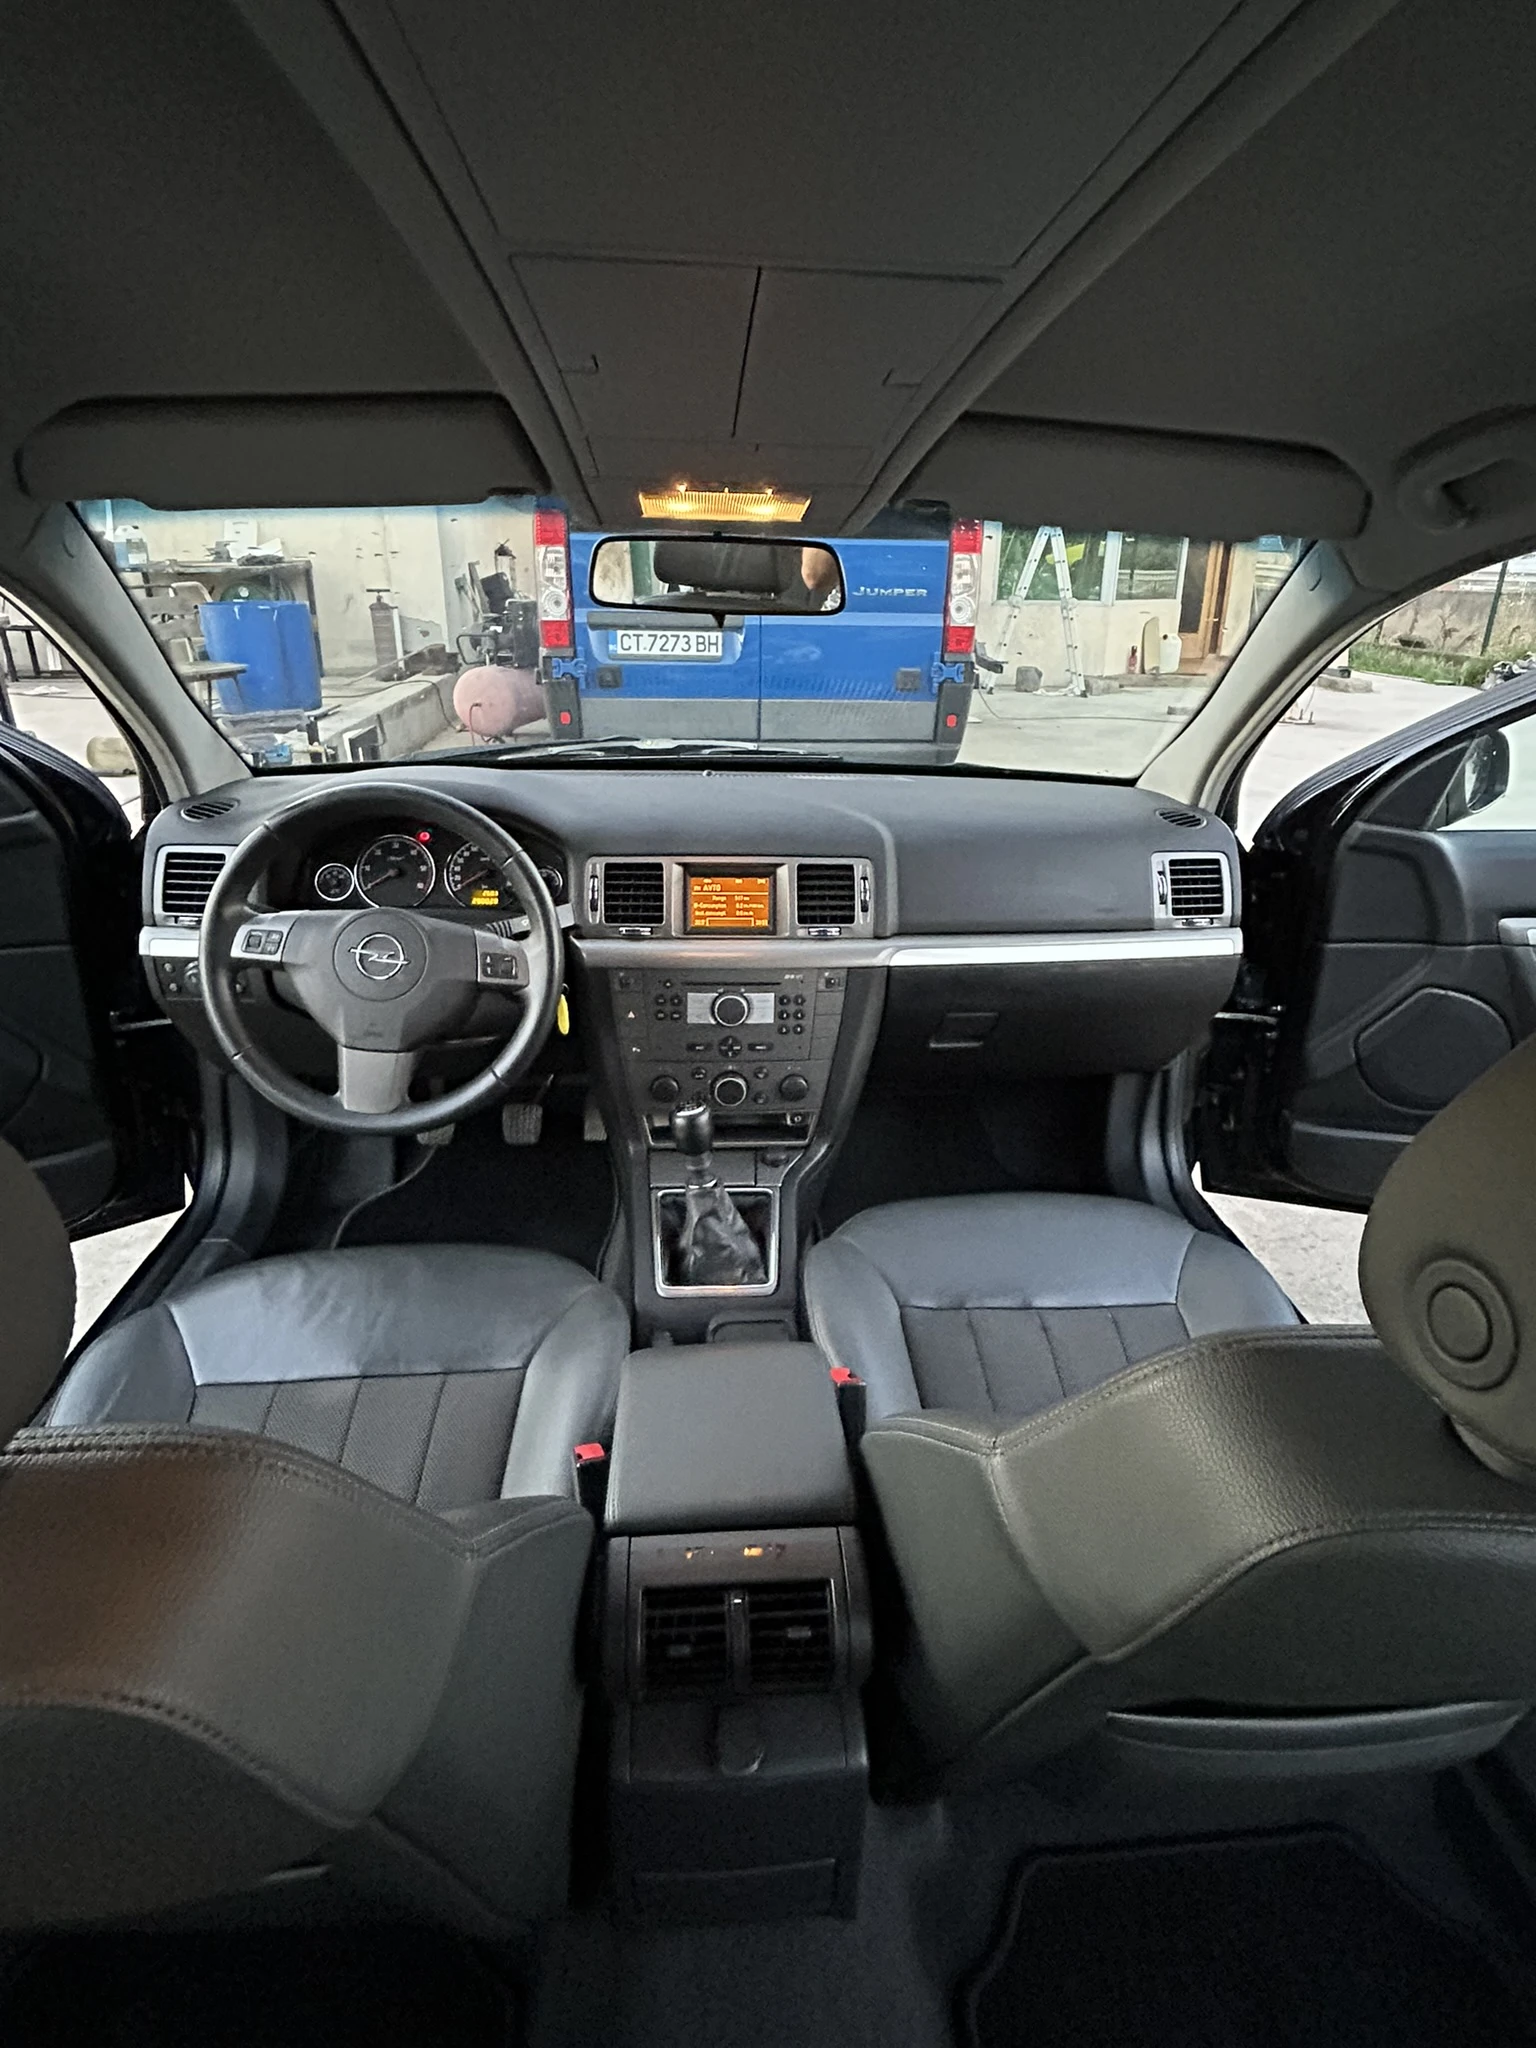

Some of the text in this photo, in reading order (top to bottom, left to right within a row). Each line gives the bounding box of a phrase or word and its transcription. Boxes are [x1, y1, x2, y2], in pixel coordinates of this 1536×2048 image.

[852, 586, 928, 597] JUMPER
[647, 633, 691, 653] 7273
[695, 634, 719, 653] BH
